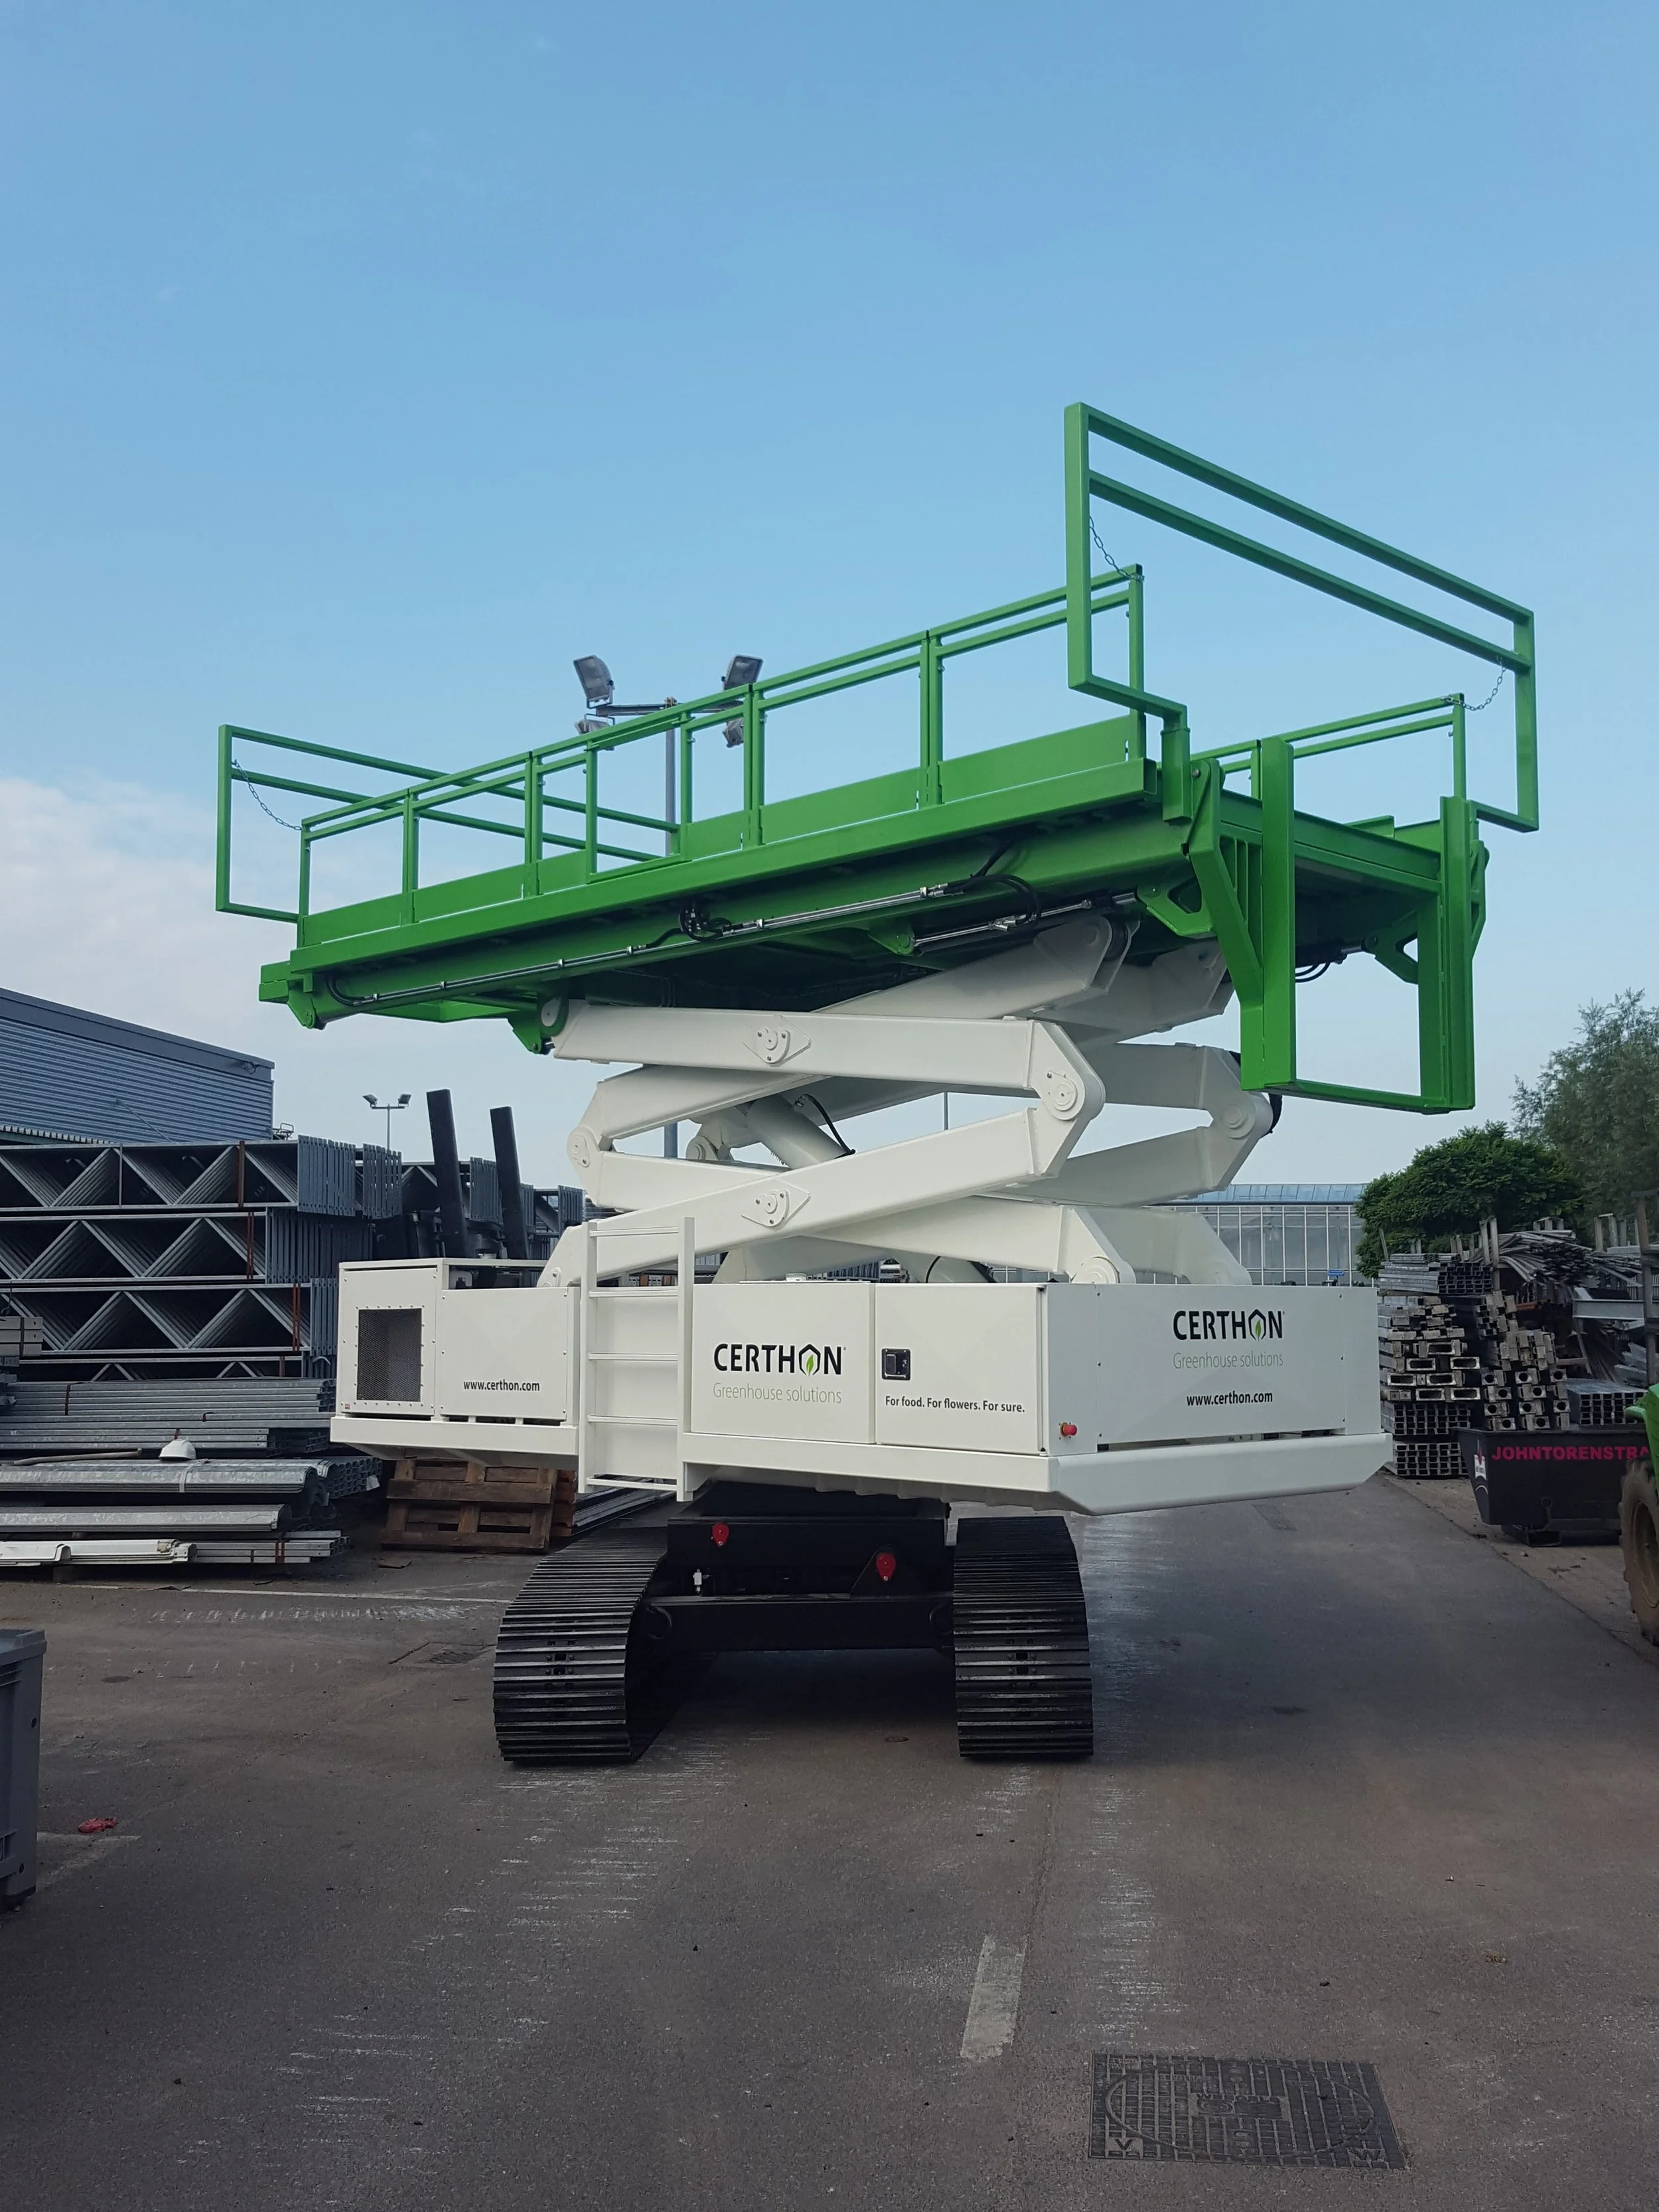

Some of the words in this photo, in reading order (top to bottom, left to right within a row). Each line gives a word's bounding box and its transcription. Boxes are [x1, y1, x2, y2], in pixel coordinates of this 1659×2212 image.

[1173, 1309, 1283, 1341] CERTHON
[713, 1343, 842, 1376] CERTHON
[1173, 1351, 1238, 1369] Greenhouse
[1240, 1350, 1284, 1368] solutions
[463, 1378, 540, 1392] www.certhon.com
[713, 1382, 783, 1401] Greenhouse
[786, 1385, 842, 1404] solutions
[885, 1395, 900, 1406] For
[901, 1396, 925, 1408] food.
[926, 1397, 942, 1408] For
[944, 1397, 981, 1411] flowers.
[983, 1400, 999, 1412] For
[1001, 1403, 1025, 1413] sure.
[1186, 1390, 1273, 1406] www.certhon.com
